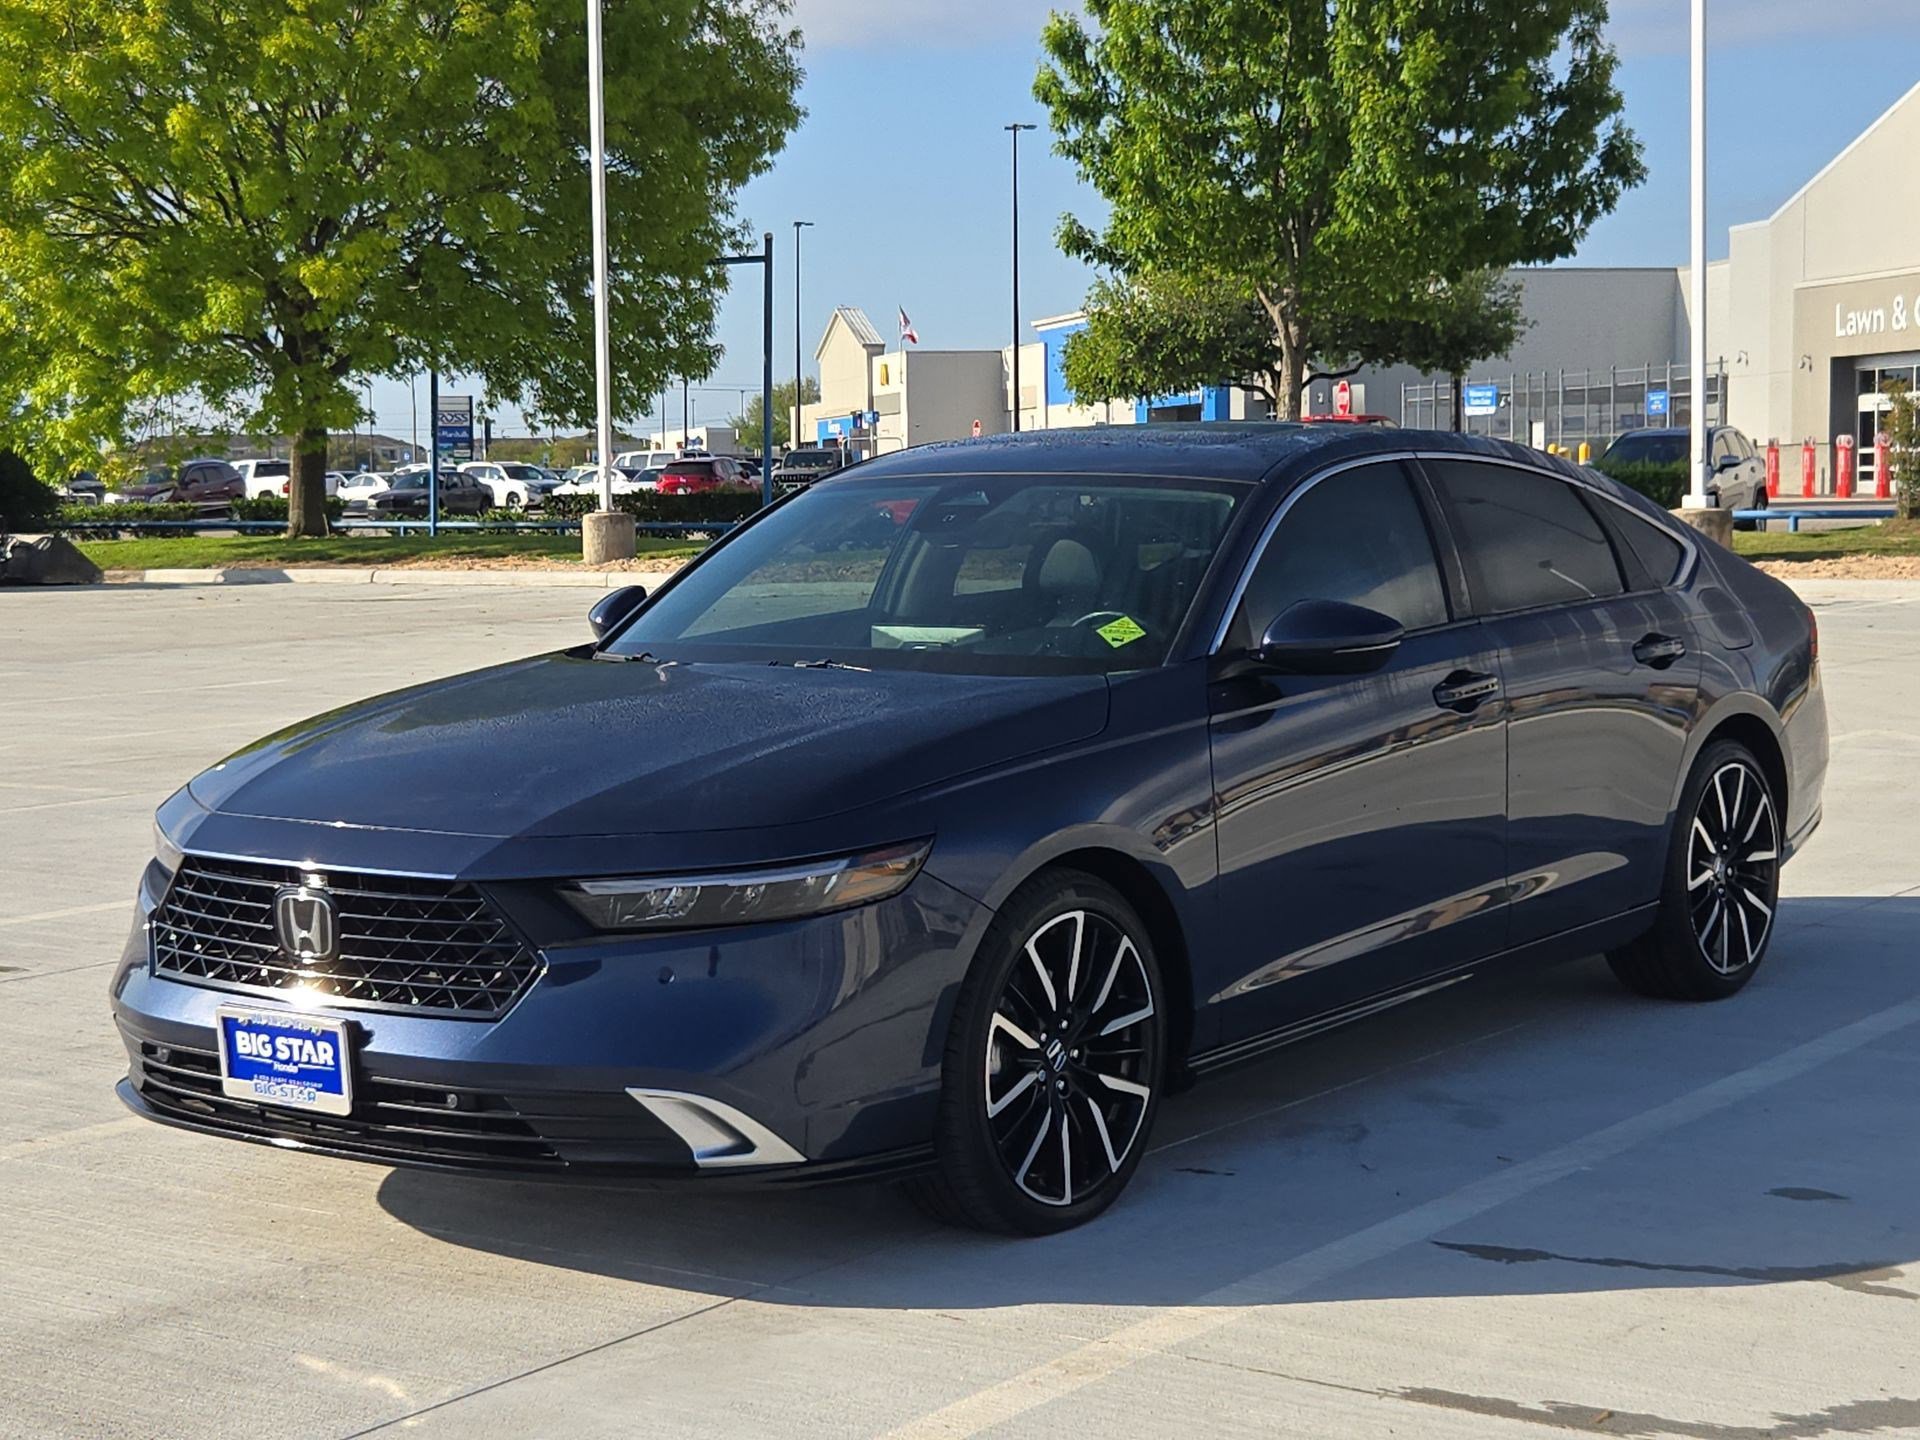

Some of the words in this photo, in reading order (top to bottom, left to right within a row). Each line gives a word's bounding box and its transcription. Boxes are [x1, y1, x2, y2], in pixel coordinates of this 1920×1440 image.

[1835, 303, 1885, 337] Lawn
[1891, 295, 1907, 332] &
[235, 1030, 273, 1058] BIG
[274, 1035, 335, 1066] STAR
[254, 1082, 277, 1097] BIG
[279, 1086, 317, 1102] STAR
